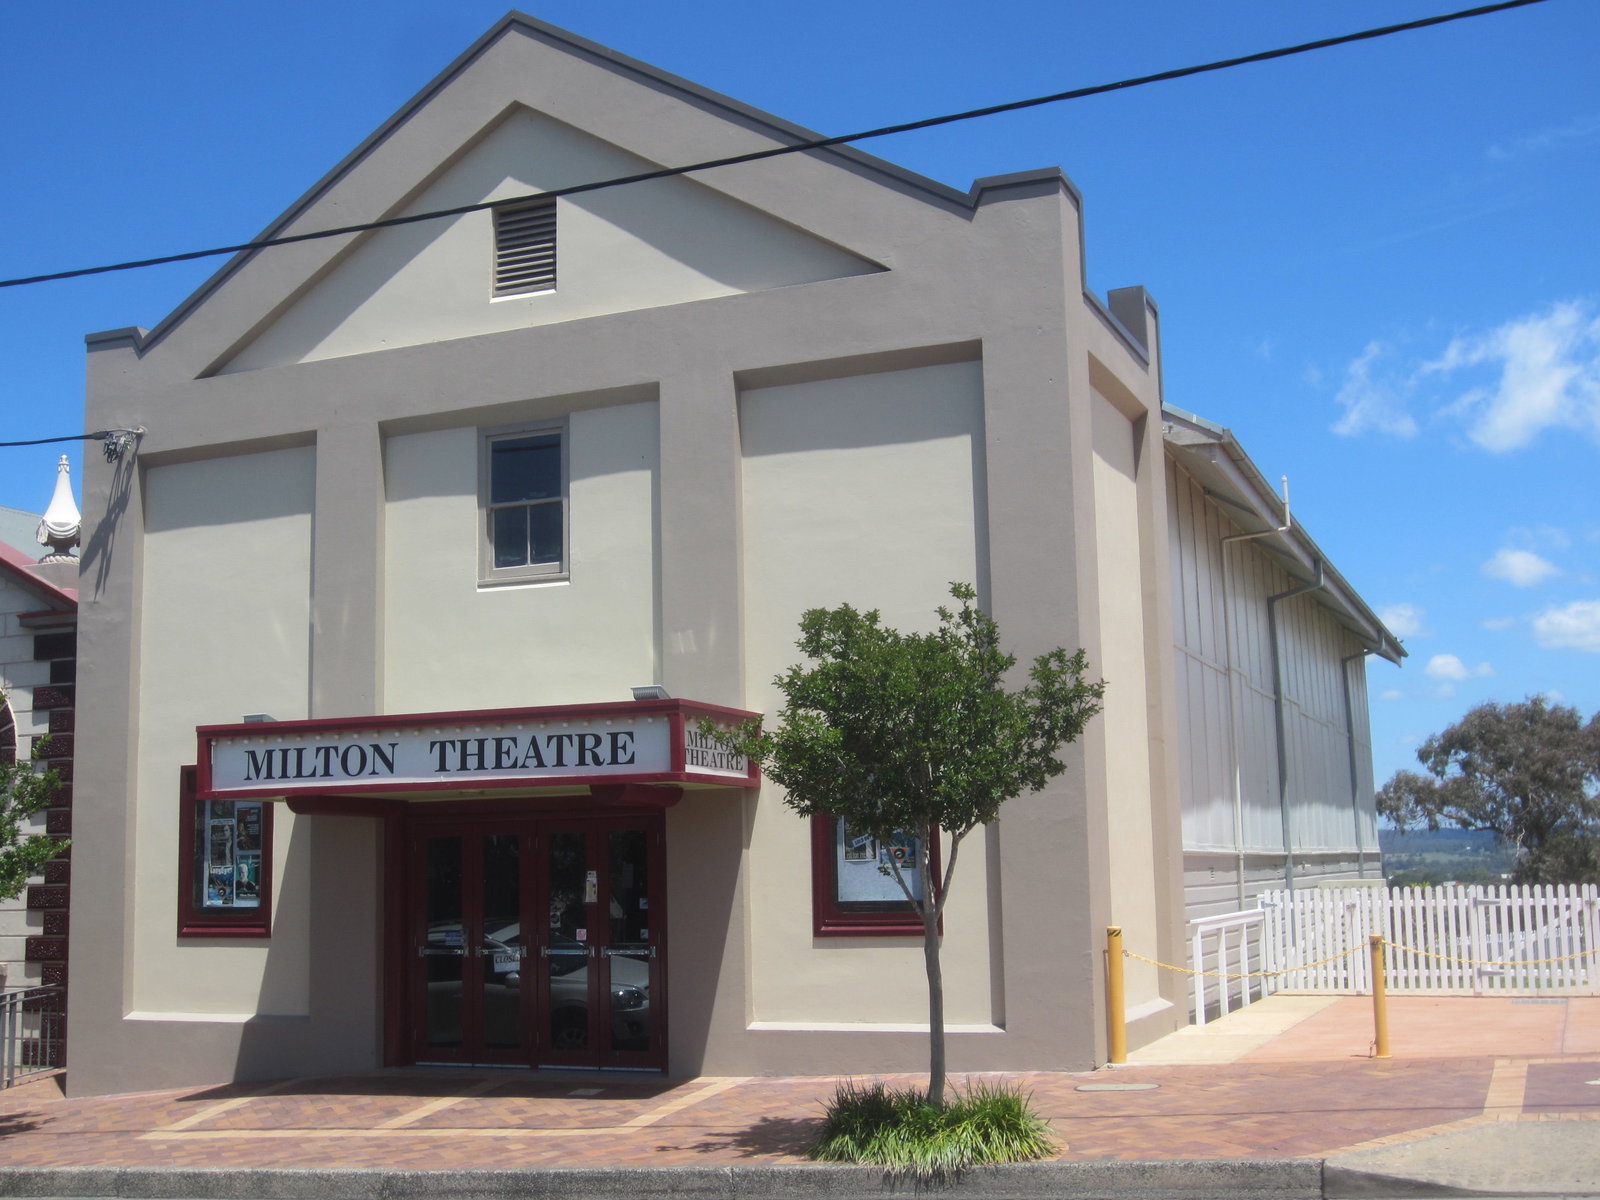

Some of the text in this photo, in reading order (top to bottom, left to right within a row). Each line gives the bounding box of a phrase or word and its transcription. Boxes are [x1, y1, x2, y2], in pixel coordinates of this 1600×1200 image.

[244, 731, 636, 781] MILTON THEATRE
[685, 748, 743, 771] THEATRE
